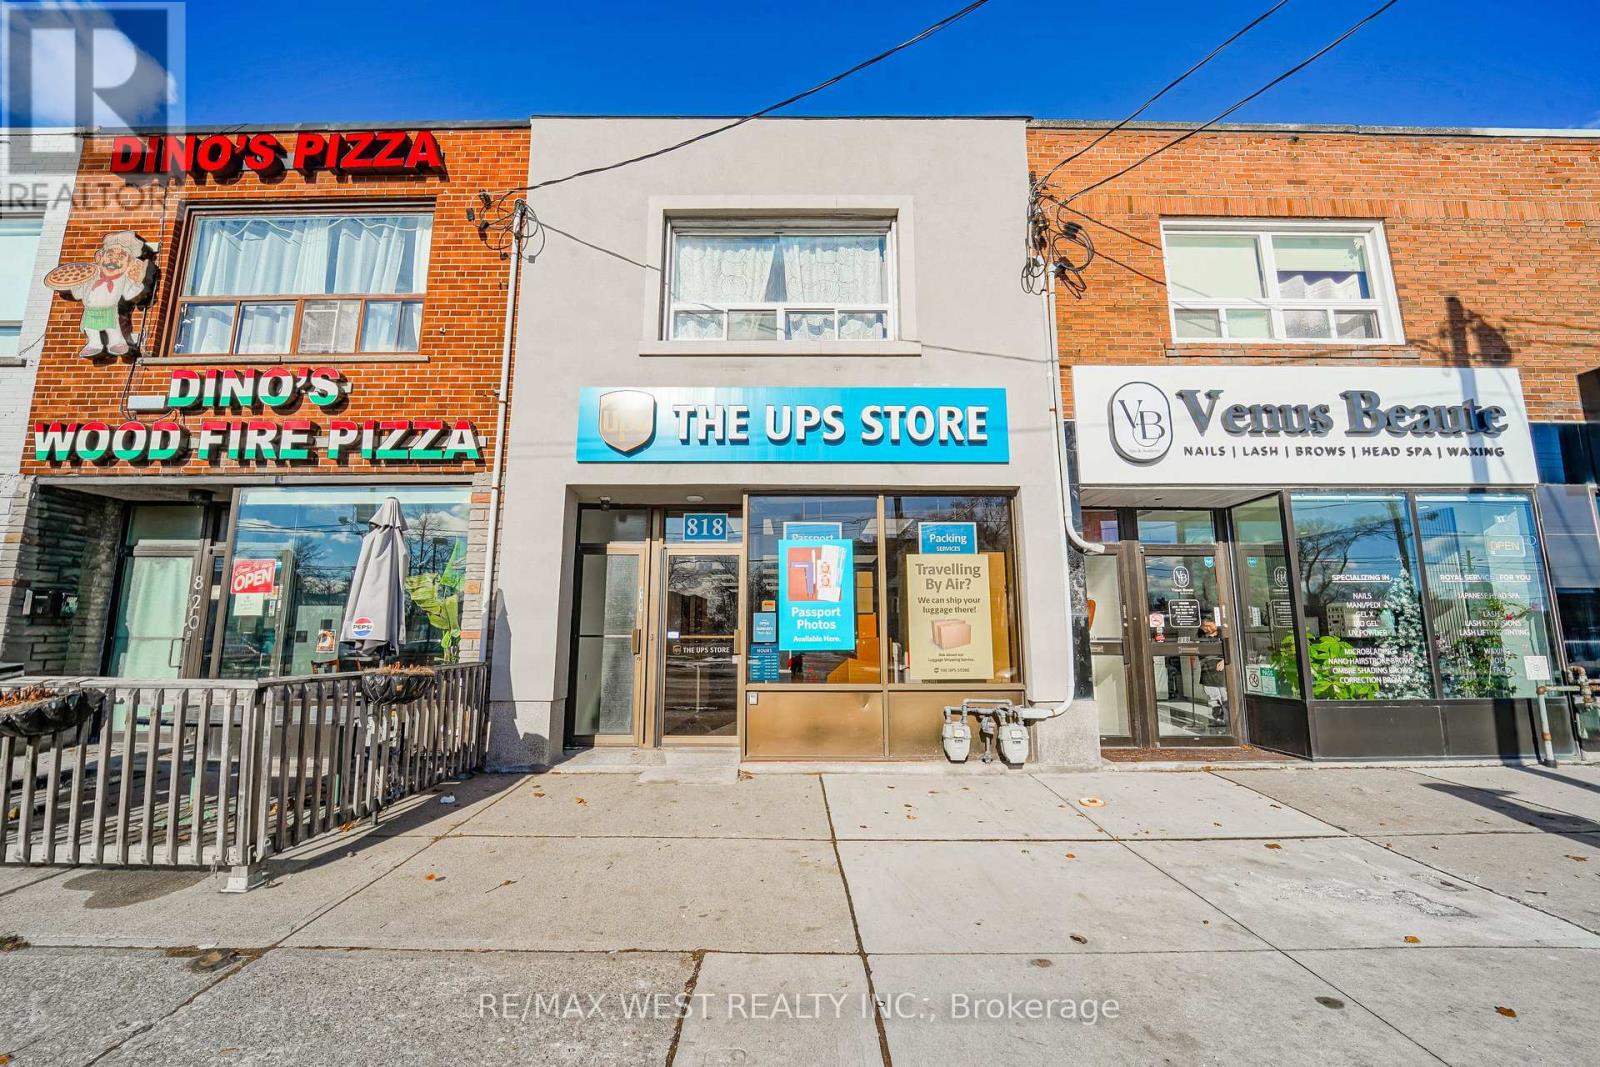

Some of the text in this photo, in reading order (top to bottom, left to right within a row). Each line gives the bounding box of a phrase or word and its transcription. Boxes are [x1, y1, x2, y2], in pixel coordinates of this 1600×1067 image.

[109, 130, 443, 171] DINO'S PIZZA
[165, 367, 341, 408] DINO'S
[1175, 389, 1509, 438] Venus Beaute
[671, 403, 990, 444] THE UPS STORE
[34, 420, 482, 462] WOOD FIRE PIZZA
[1183, 446, 1505, 457] NAILS LASH BROWS HEAD SPA WAXING
[687, 518, 723, 536] 818
[929, 533, 968, 545] Packing
[914, 562, 982, 579] Travelling
[234, 567, 273, 592] OPEN
[925, 578, 972, 593] By Air?
[917, 596, 931, 604] We
[945, 596, 962, 606] ship
[963, 597, 981, 606] your
[1352, 592, 1372, 600] NAILS
[791, 606, 842, 619] Passport
[923, 606, 977, 615] luggage there!
[796, 619, 837, 630] Photos
